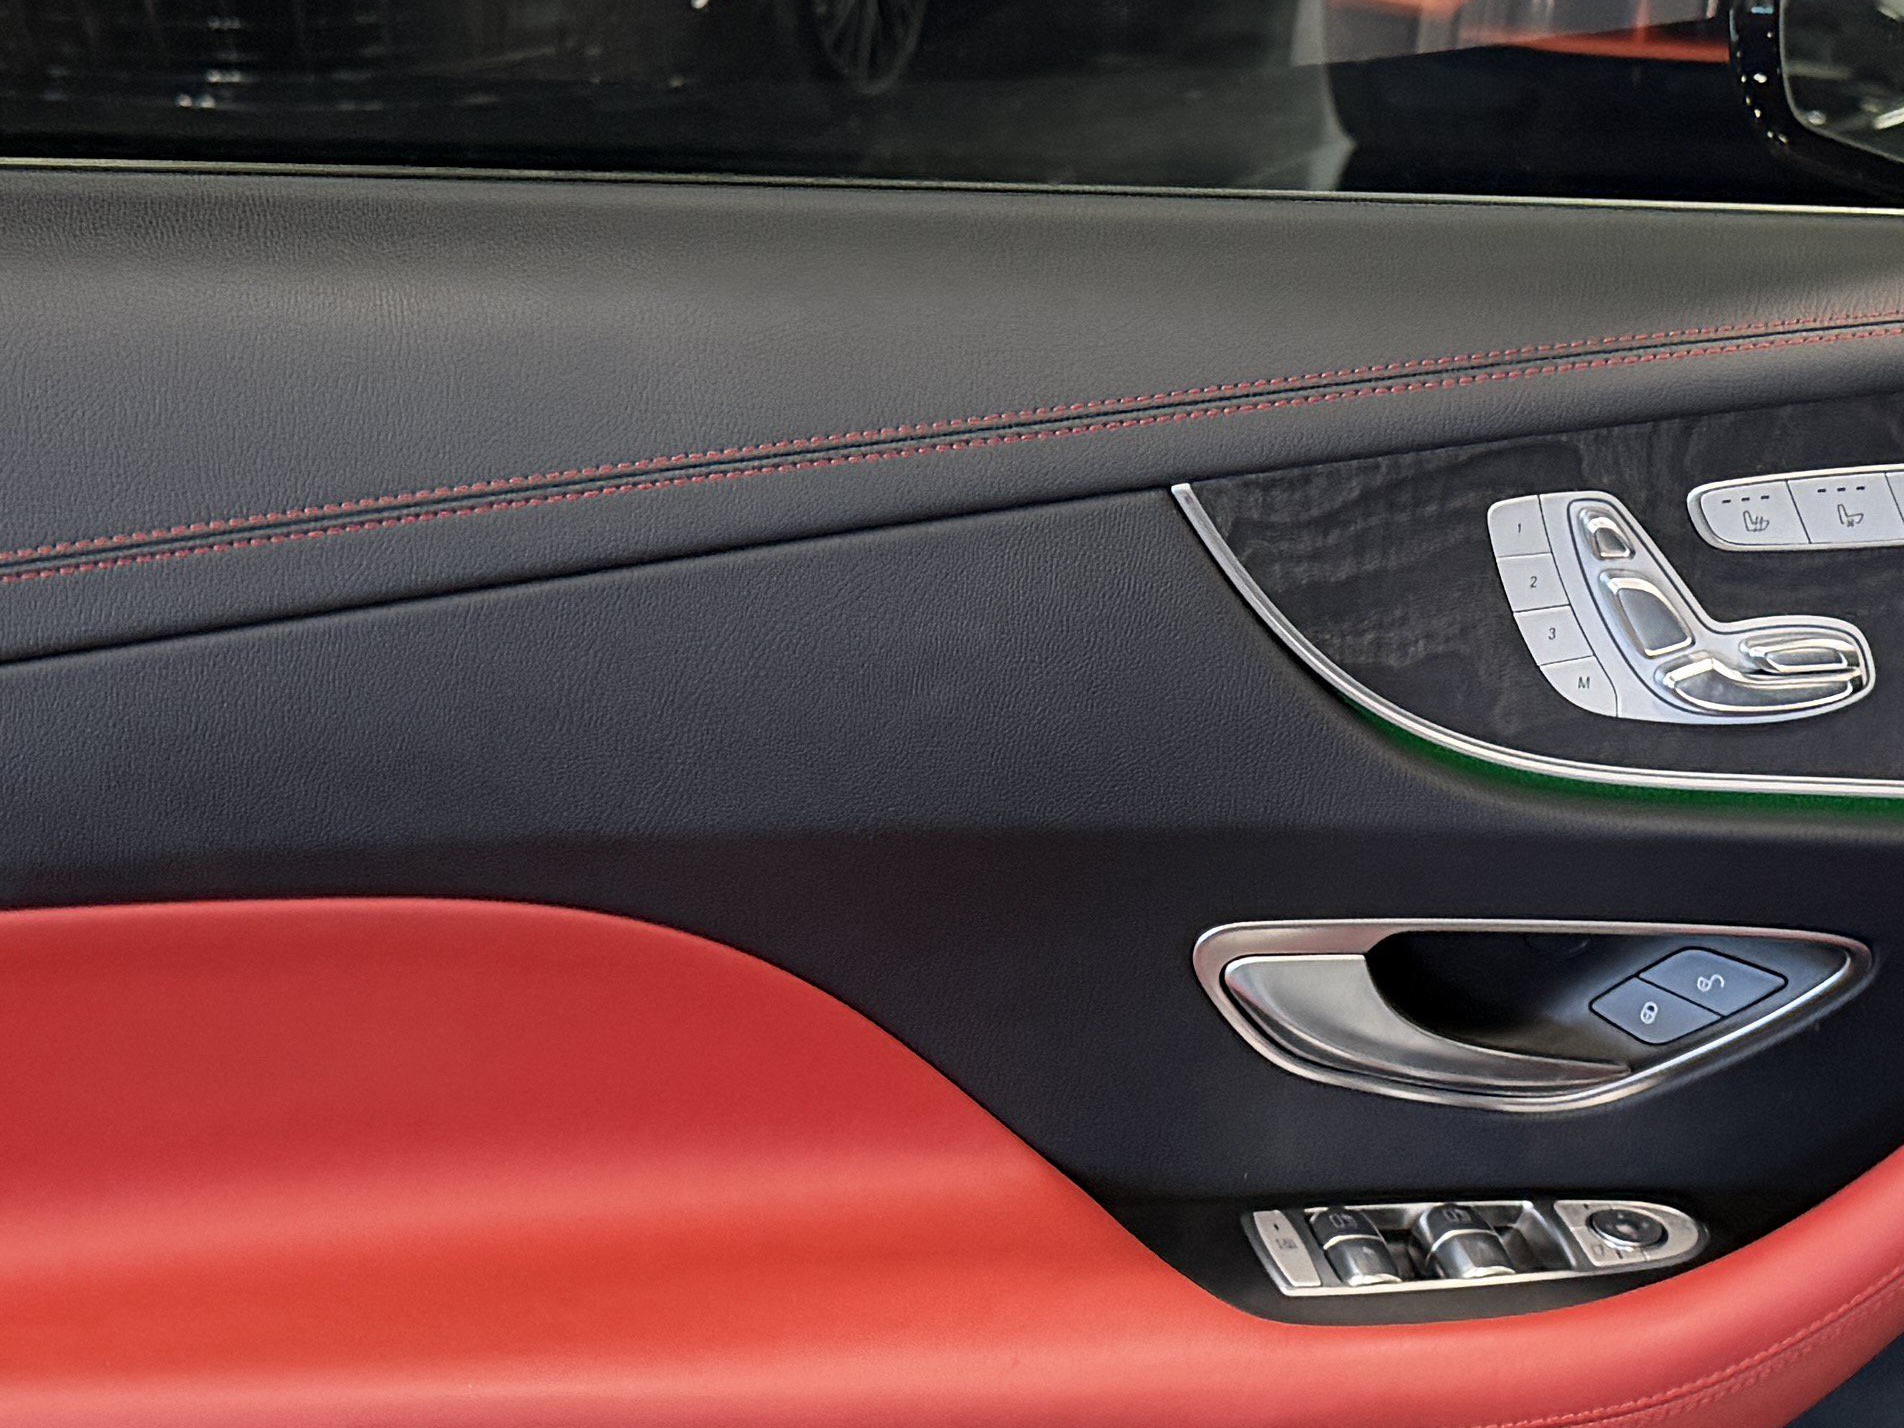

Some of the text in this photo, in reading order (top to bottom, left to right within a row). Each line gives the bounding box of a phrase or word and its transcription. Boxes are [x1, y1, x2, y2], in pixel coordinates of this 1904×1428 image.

[1529, 575, 1538, 589] 2
[1547, 627, 1557, 641] 3
[1577, 676, 1592, 690] M
